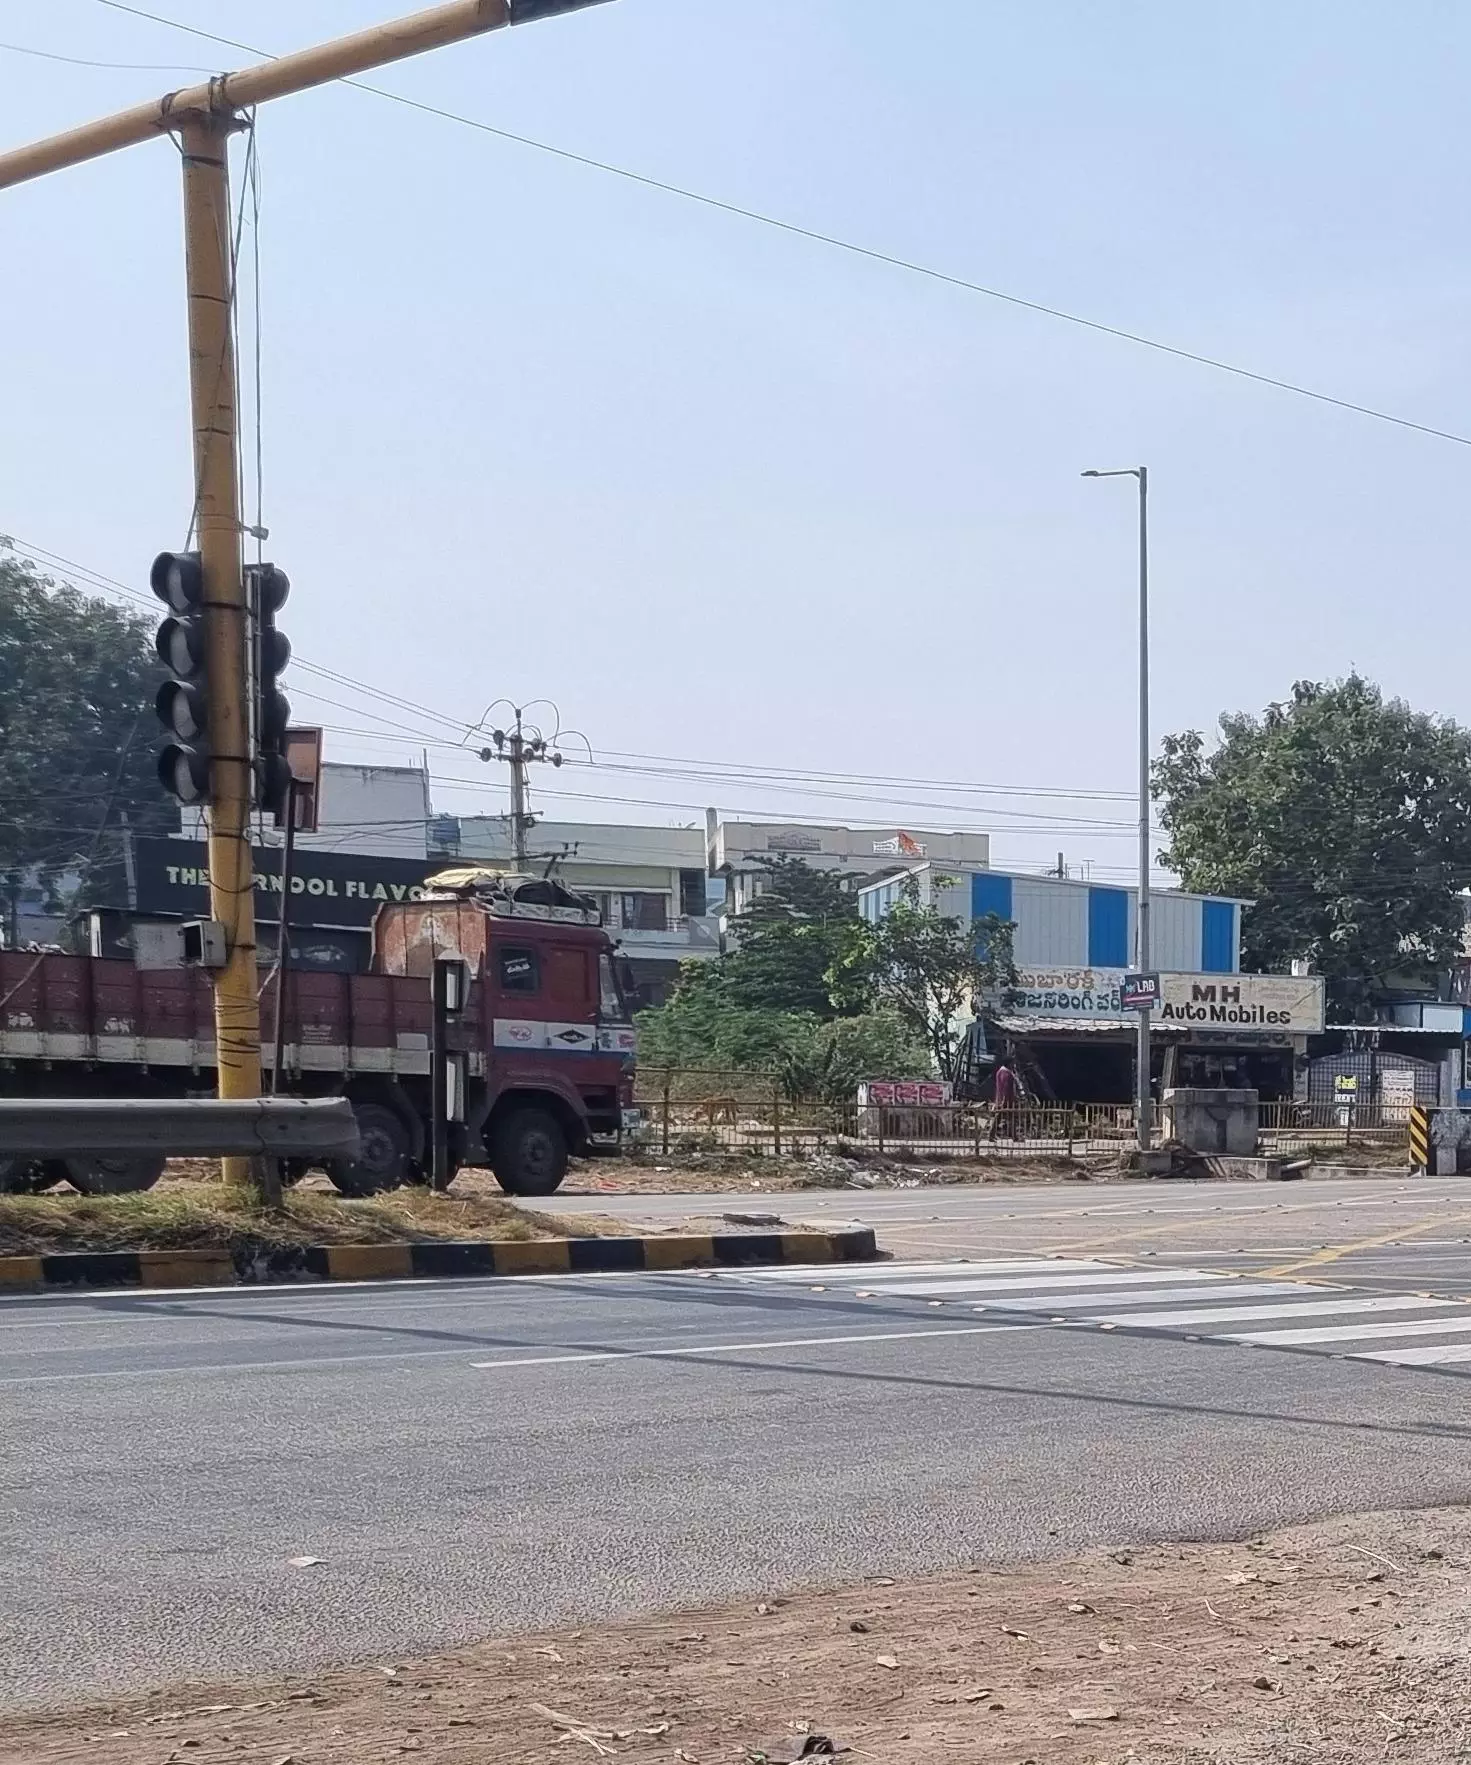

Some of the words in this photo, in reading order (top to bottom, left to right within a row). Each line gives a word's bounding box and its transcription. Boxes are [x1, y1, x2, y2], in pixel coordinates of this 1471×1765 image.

[166, 866, 210, 886] THE
[252, 873, 338, 897] RNOOL
[345, 881, 424, 901] FLAVO
[1191, 984, 1241, 1003] MH
[1162, 1002, 1207, 1020] Auto
[1210, 1004, 1292, 1025] Mobiles
